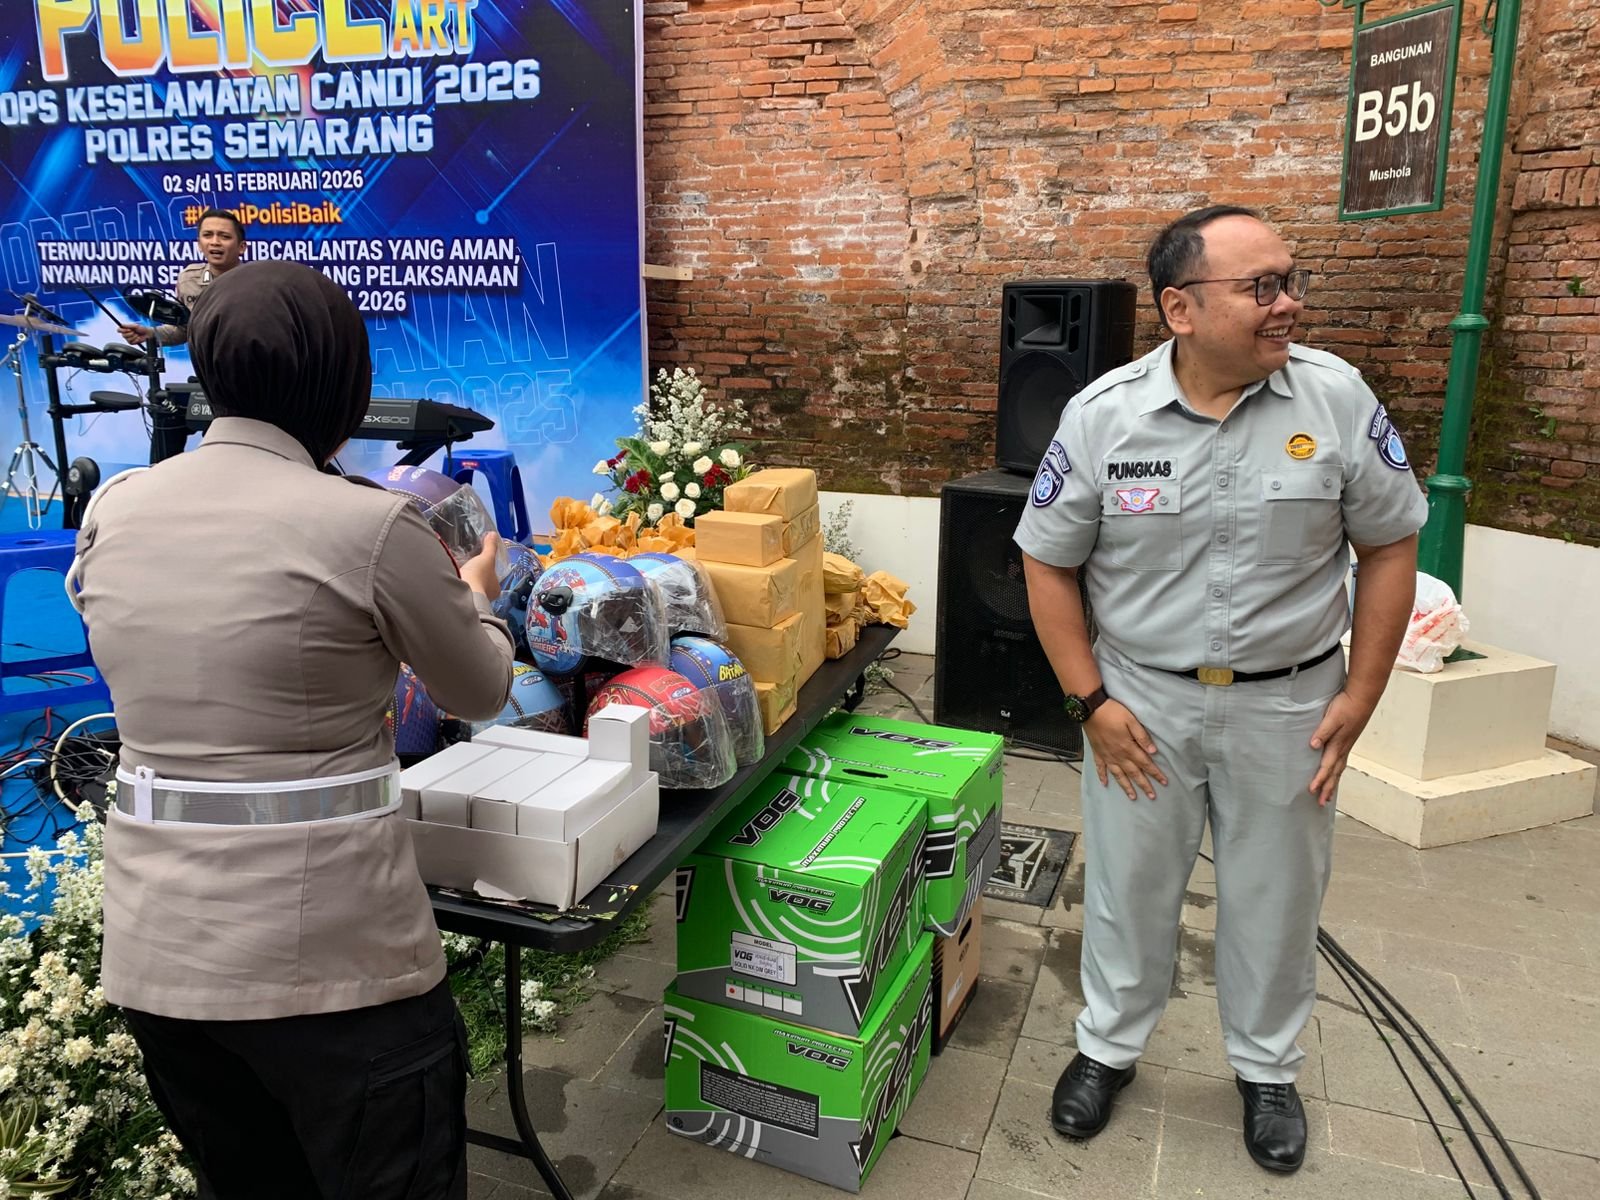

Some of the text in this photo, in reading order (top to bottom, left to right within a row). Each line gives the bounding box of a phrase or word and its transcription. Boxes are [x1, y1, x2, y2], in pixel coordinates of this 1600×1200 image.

[33, 0, 477, 81] POLICE ART
[1370, 41, 1432, 67] BANGUNAN
[1, 58, 541, 126] OPS KESELAMATAN CANDI 2026
[1355, 81, 1436, 142] B5b
[85, 114, 434, 164] POLRES SEMARANG
[163, 169, 364, 193] 02 s/d 15 FEBRUARI 2026
[1369, 166, 1411, 182] Mushola
[37, 241, 166, 261] TERWUJUDNYA
[388, 239, 444, 260] YANG
[449, 238, 520, 264] AMAN,
[42, 265, 114, 284] NYAMAN
[118, 265, 154, 284] DAN
[366, 265, 518, 287] PELAKSANAAN
[358, 290, 407, 312] 2026
[1108, 461, 1172, 480] PUNGKAS
[849, 726, 960, 750] VOG
[728, 787, 801, 847] VOG
[832, 797, 866, 834] PROTECTION
[768, 887, 834, 912] VOG
[734, 949, 753, 961] VOG
[753, 939, 773, 948] MODEL
[786, 1040, 852, 1071] VOG
